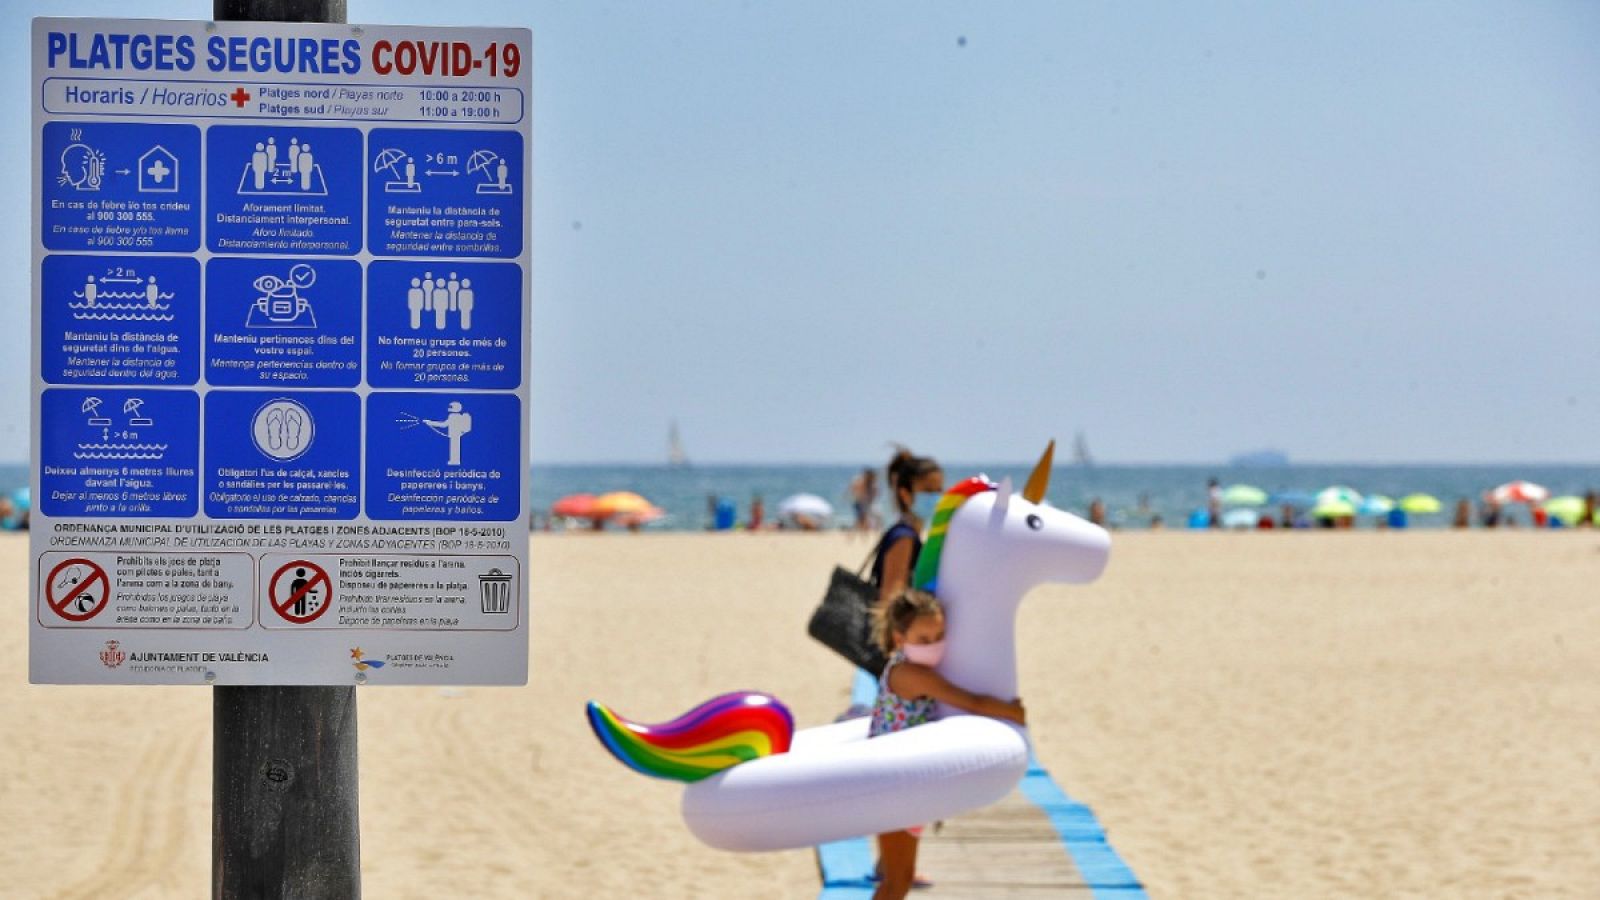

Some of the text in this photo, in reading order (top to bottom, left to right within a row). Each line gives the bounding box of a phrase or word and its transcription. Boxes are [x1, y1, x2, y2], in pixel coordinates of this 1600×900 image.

[48, 32, 521, 78] PLATGES SEGURES COVID-19
[66, 86, 135, 104] Horaris
[152, 88, 227, 106] Horarios
[259, 88, 300, 101] Platges
[304, 89, 329, 98] nord
[338, 90, 372, 101] Playas
[420, 91, 448, 101] 10:00
[462, 91, 490, 102] 20:00
[259, 104, 300, 115] Platges
[304, 105, 325, 114] sud
[420, 107, 448, 117] 11:00
[462, 108, 490, 117] 19:00
[436, 153, 444, 164] 6
[52, 200, 65, 209] En
[88, 200, 98, 209] de
[102, 200, 125, 209] febre
[243, 204, 326, 212] Aforament limitat.
[86, 212, 95, 220] al
[97, 212, 113, 220] 900
[117, 212, 133, 221] 300
[217, 213, 351, 225] Distanciament interpersonal.
[98, 237, 113, 245] 900
[117, 237, 133, 246] 300
[65, 332, 108, 341] Manteniu
[110, 332, 119, 341] la
[168, 333, 178, 341] de
[214, 334, 257, 343] Manteniu
[317, 336, 337, 344] dins
[340, 336, 354, 344] del
[378, 336, 391, 345] No
[394, 336, 427, 346] formeu
[430, 338, 456, 347] grups
[459, 338, 470, 346] de
[495, 338, 506, 347] de
[110, 344, 129, 352] dins
[132, 344, 144, 352] de
[413, 349, 424, 358] 20
[414, 373, 425, 381] 20
[80, 467, 119, 477] almenys
[131, 467, 162, 475] metres
[277, 469, 287, 477] de
[489, 470, 500, 478] de
[85, 478, 117, 487] davant
[54, 524, 117, 534] ORDENANÇA
[120, 525, 173, 533] MUNICIPAL
[247, 526, 260, 534] DE
[264, 526, 282, 534] LES
[285, 526, 328, 535] PLATGES
[336, 526, 370, 535] ZONES
[372, 527, 430, 535] ADJACENTS
[130, 651, 268, 662] AJUNTAMENT DE VALÈNCIA
